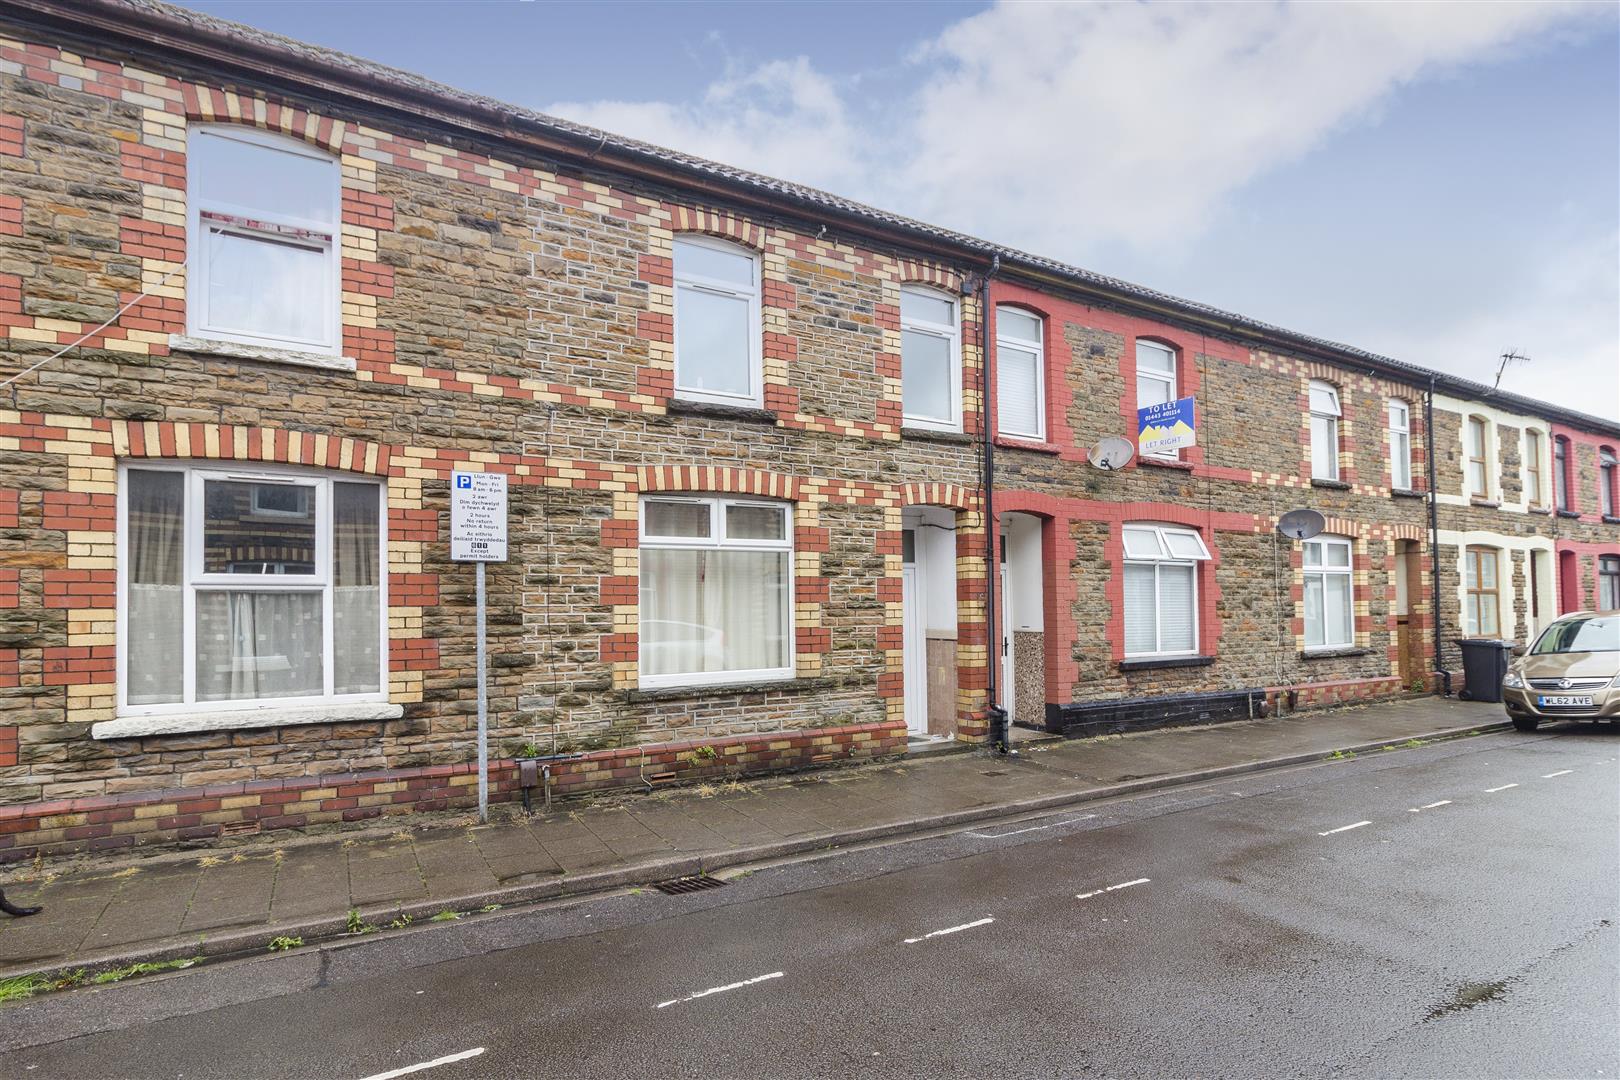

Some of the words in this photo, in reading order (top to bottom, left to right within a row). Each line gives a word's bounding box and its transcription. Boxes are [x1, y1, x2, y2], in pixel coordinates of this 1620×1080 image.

[1163, 401, 1176, 410] LET
[1160, 436, 1180, 446] RIGHT
[461, 476, 469, 487] P
